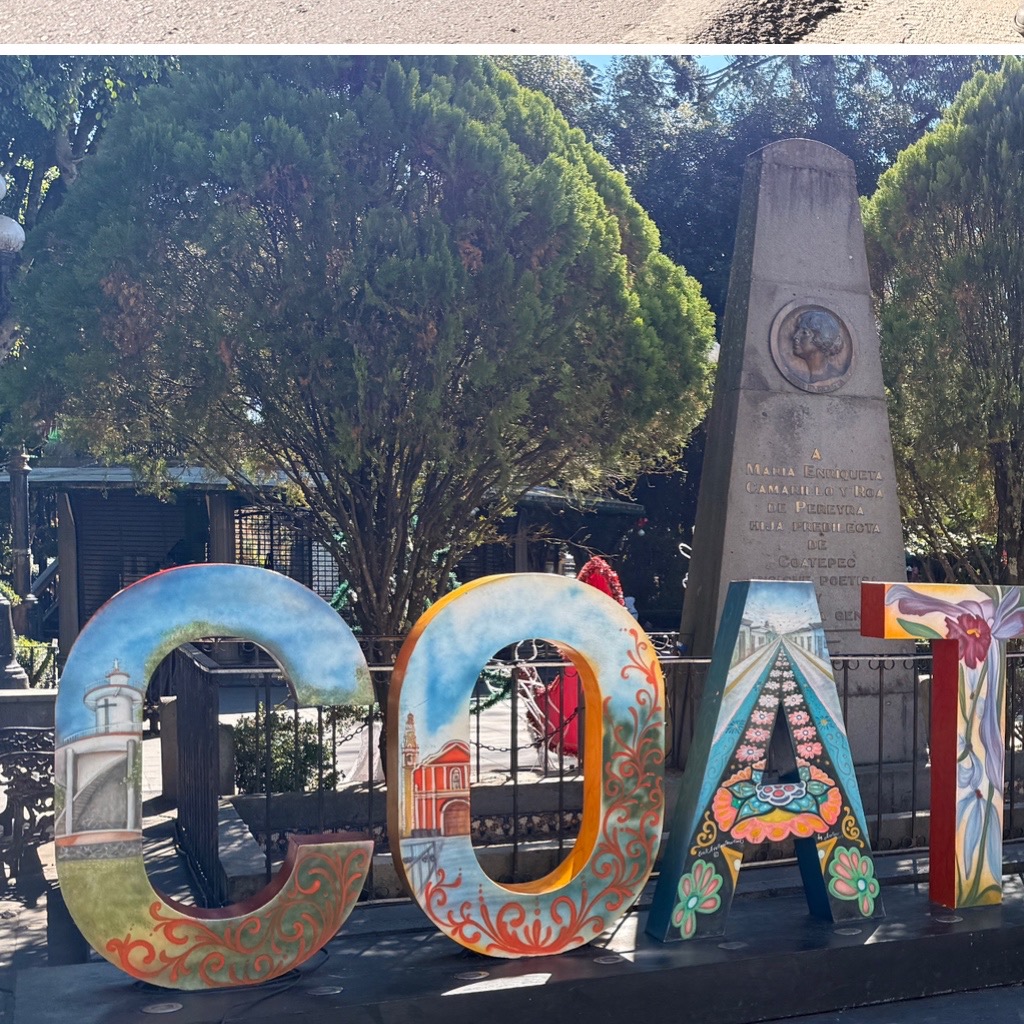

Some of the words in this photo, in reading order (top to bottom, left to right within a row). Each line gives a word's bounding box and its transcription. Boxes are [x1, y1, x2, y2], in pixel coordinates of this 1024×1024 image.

[811, 447, 822, 461] A
[803, 463, 884, 482] ENRIQUETA
[839, 486, 850, 497] Y
[853, 484, 884, 498] ROA
[767, 502, 787, 514] DE
[794, 500, 865, 516] PEREYRA
[748, 520, 785, 532] HIJA
[806, 539, 828, 551] DE
[777, 555, 857, 570] COATEPEC
